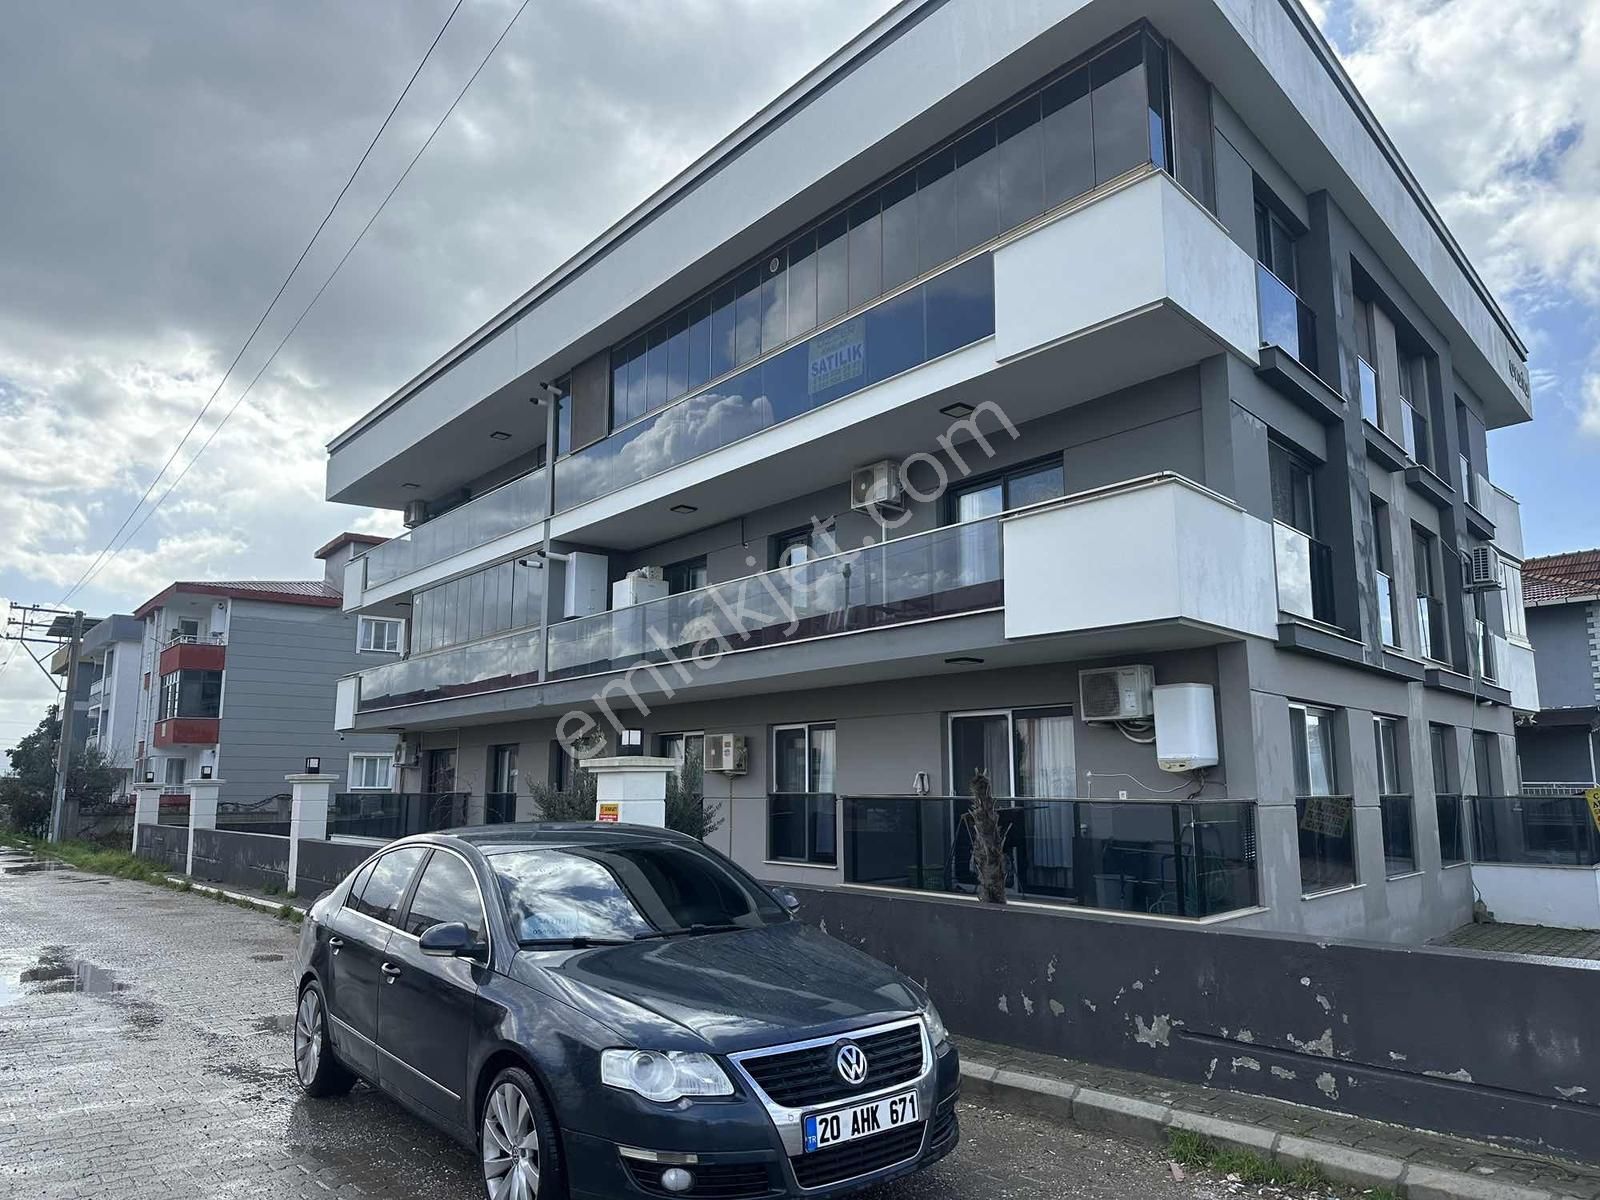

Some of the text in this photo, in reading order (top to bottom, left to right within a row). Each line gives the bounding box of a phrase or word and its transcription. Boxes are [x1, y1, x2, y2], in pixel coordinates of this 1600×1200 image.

[811, 343, 863, 377] SATILIK
[808, 1094, 916, 1144] TR 20 AHK 671
